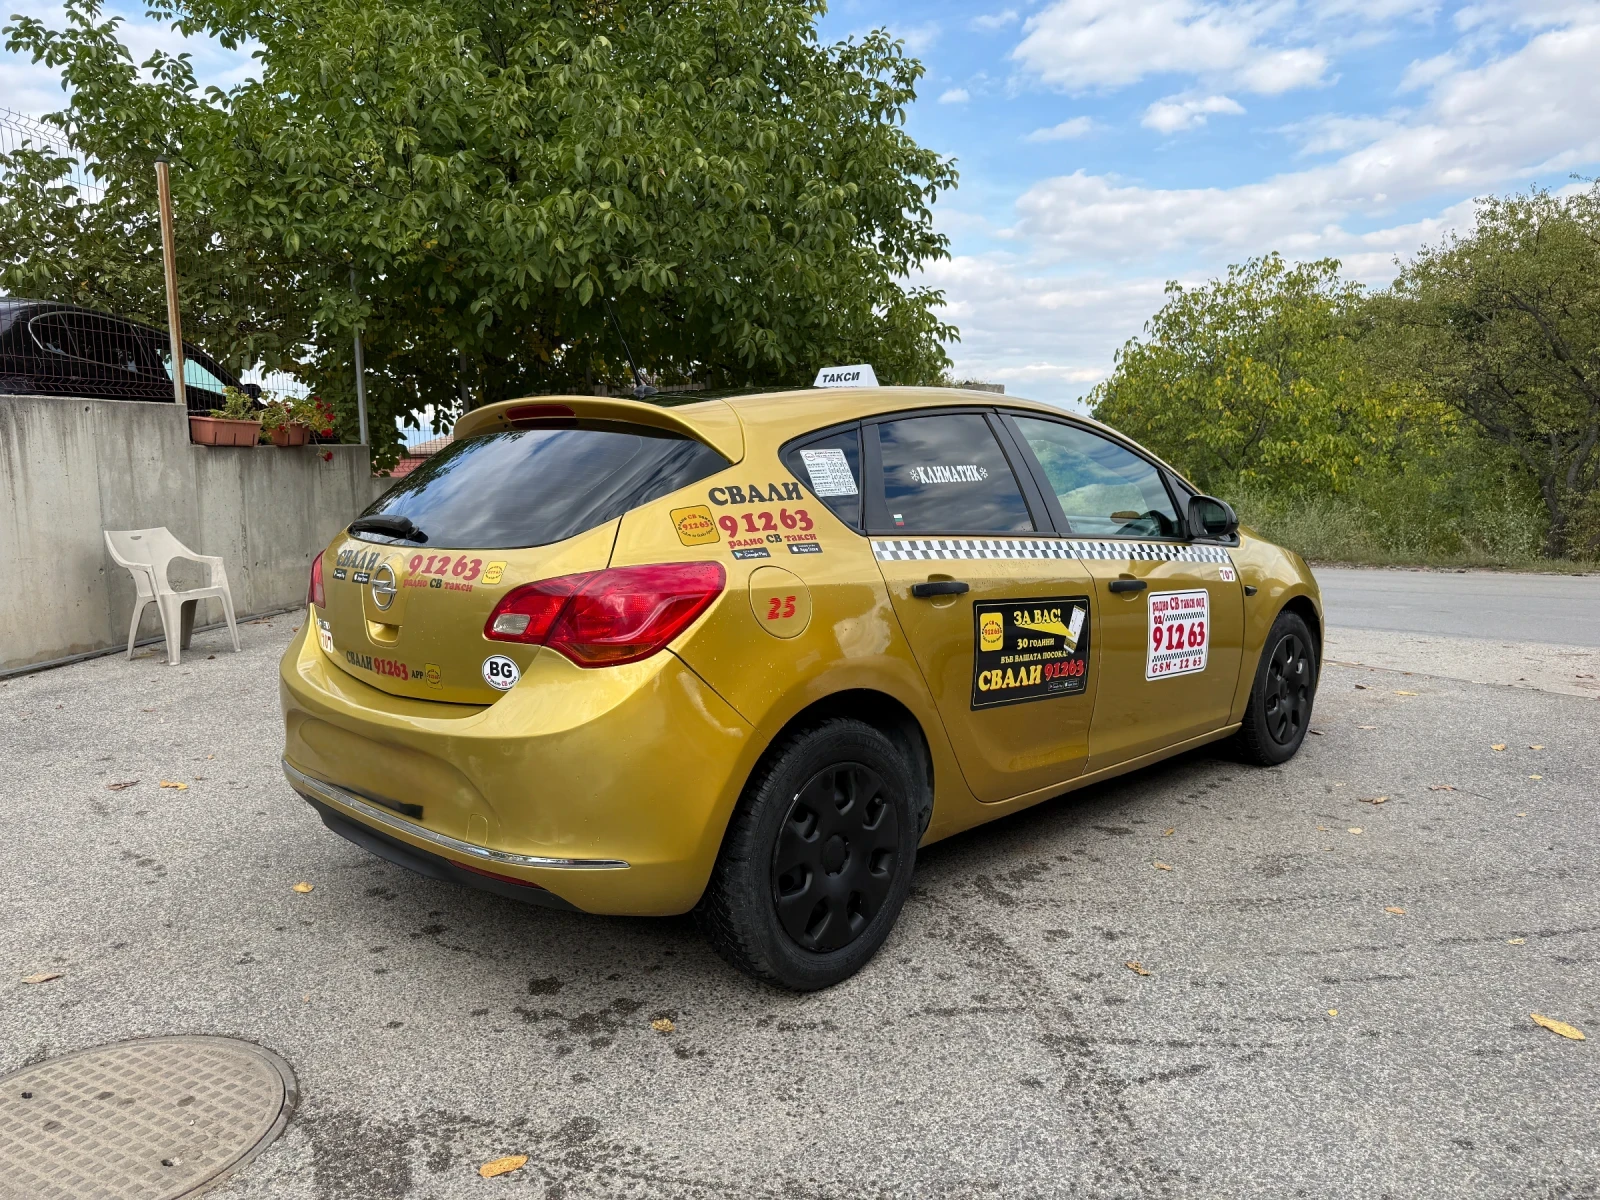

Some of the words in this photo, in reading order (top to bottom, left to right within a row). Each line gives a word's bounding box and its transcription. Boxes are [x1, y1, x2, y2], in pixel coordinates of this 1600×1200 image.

[822, 371, 861, 383] ТАКСИ
[916, 464, 983, 484] КЛИМАТИК
[708, 482, 804, 506] СВАЛИ
[718, 508, 814, 539] 91263
[728, 537, 764, 549] радио
[766, 533, 782, 543] СВ
[784, 533, 817, 542] такси
[336, 549, 381, 572] СВАЛИ
[408, 554, 483, 581] 91263
[402, 578, 428, 588] радио
[429, 578, 443, 589] СВ
[444, 581, 473, 592] такси
[767, 595, 797, 620] 25
[1152, 600, 1169, 614] радио
[1169, 597, 1180, 611] СВ
[1180, 598, 1195, 609] такси
[1013, 610, 1031, 626] ЗА
[1033, 608, 1061, 624] ВАС!
[1017, 638, 1028, 649] 30
[345, 650, 373, 671] СВАЛИ
[373, 657, 409, 681] 91263
[1014, 652, 1042, 663] ВАШАТА
[490, 660, 513, 678] BG
[978, 664, 1043, 692] СВАЛИ
[1043, 658, 1085, 681] 91263
[1152, 660, 1171, 674] GSM
